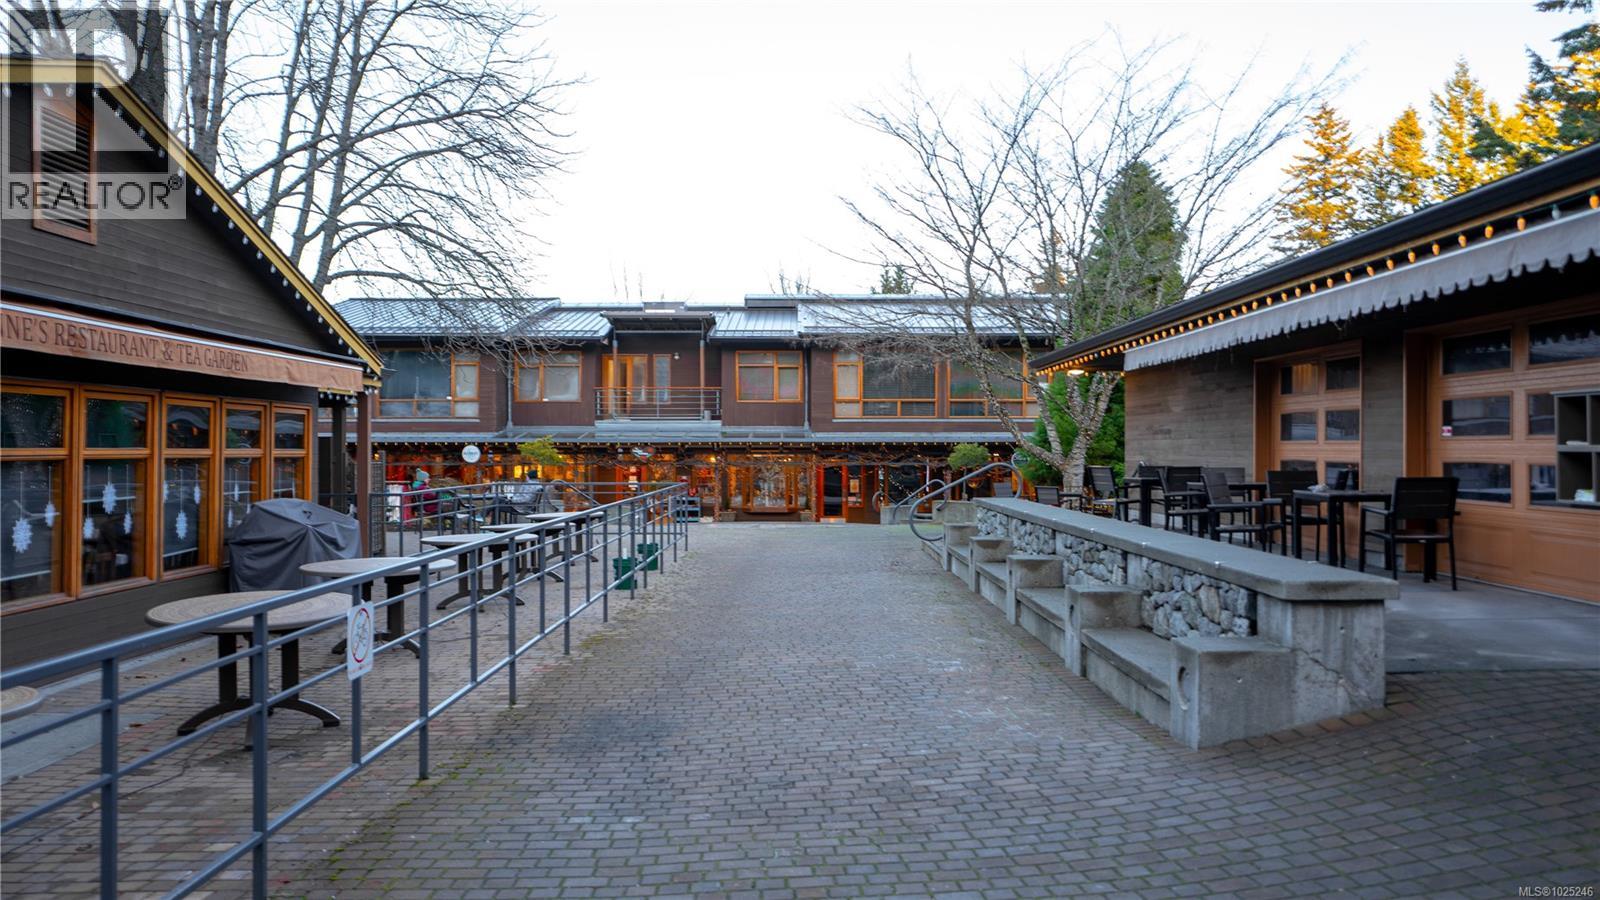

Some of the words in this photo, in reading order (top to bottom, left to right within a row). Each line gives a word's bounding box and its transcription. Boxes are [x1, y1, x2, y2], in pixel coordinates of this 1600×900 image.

[54, 322, 159, 360] RESTAURANT
[162, 340, 173, 362] &
[176, 343, 201, 366] TEA
[203, 347, 248, 372] GARDEN
